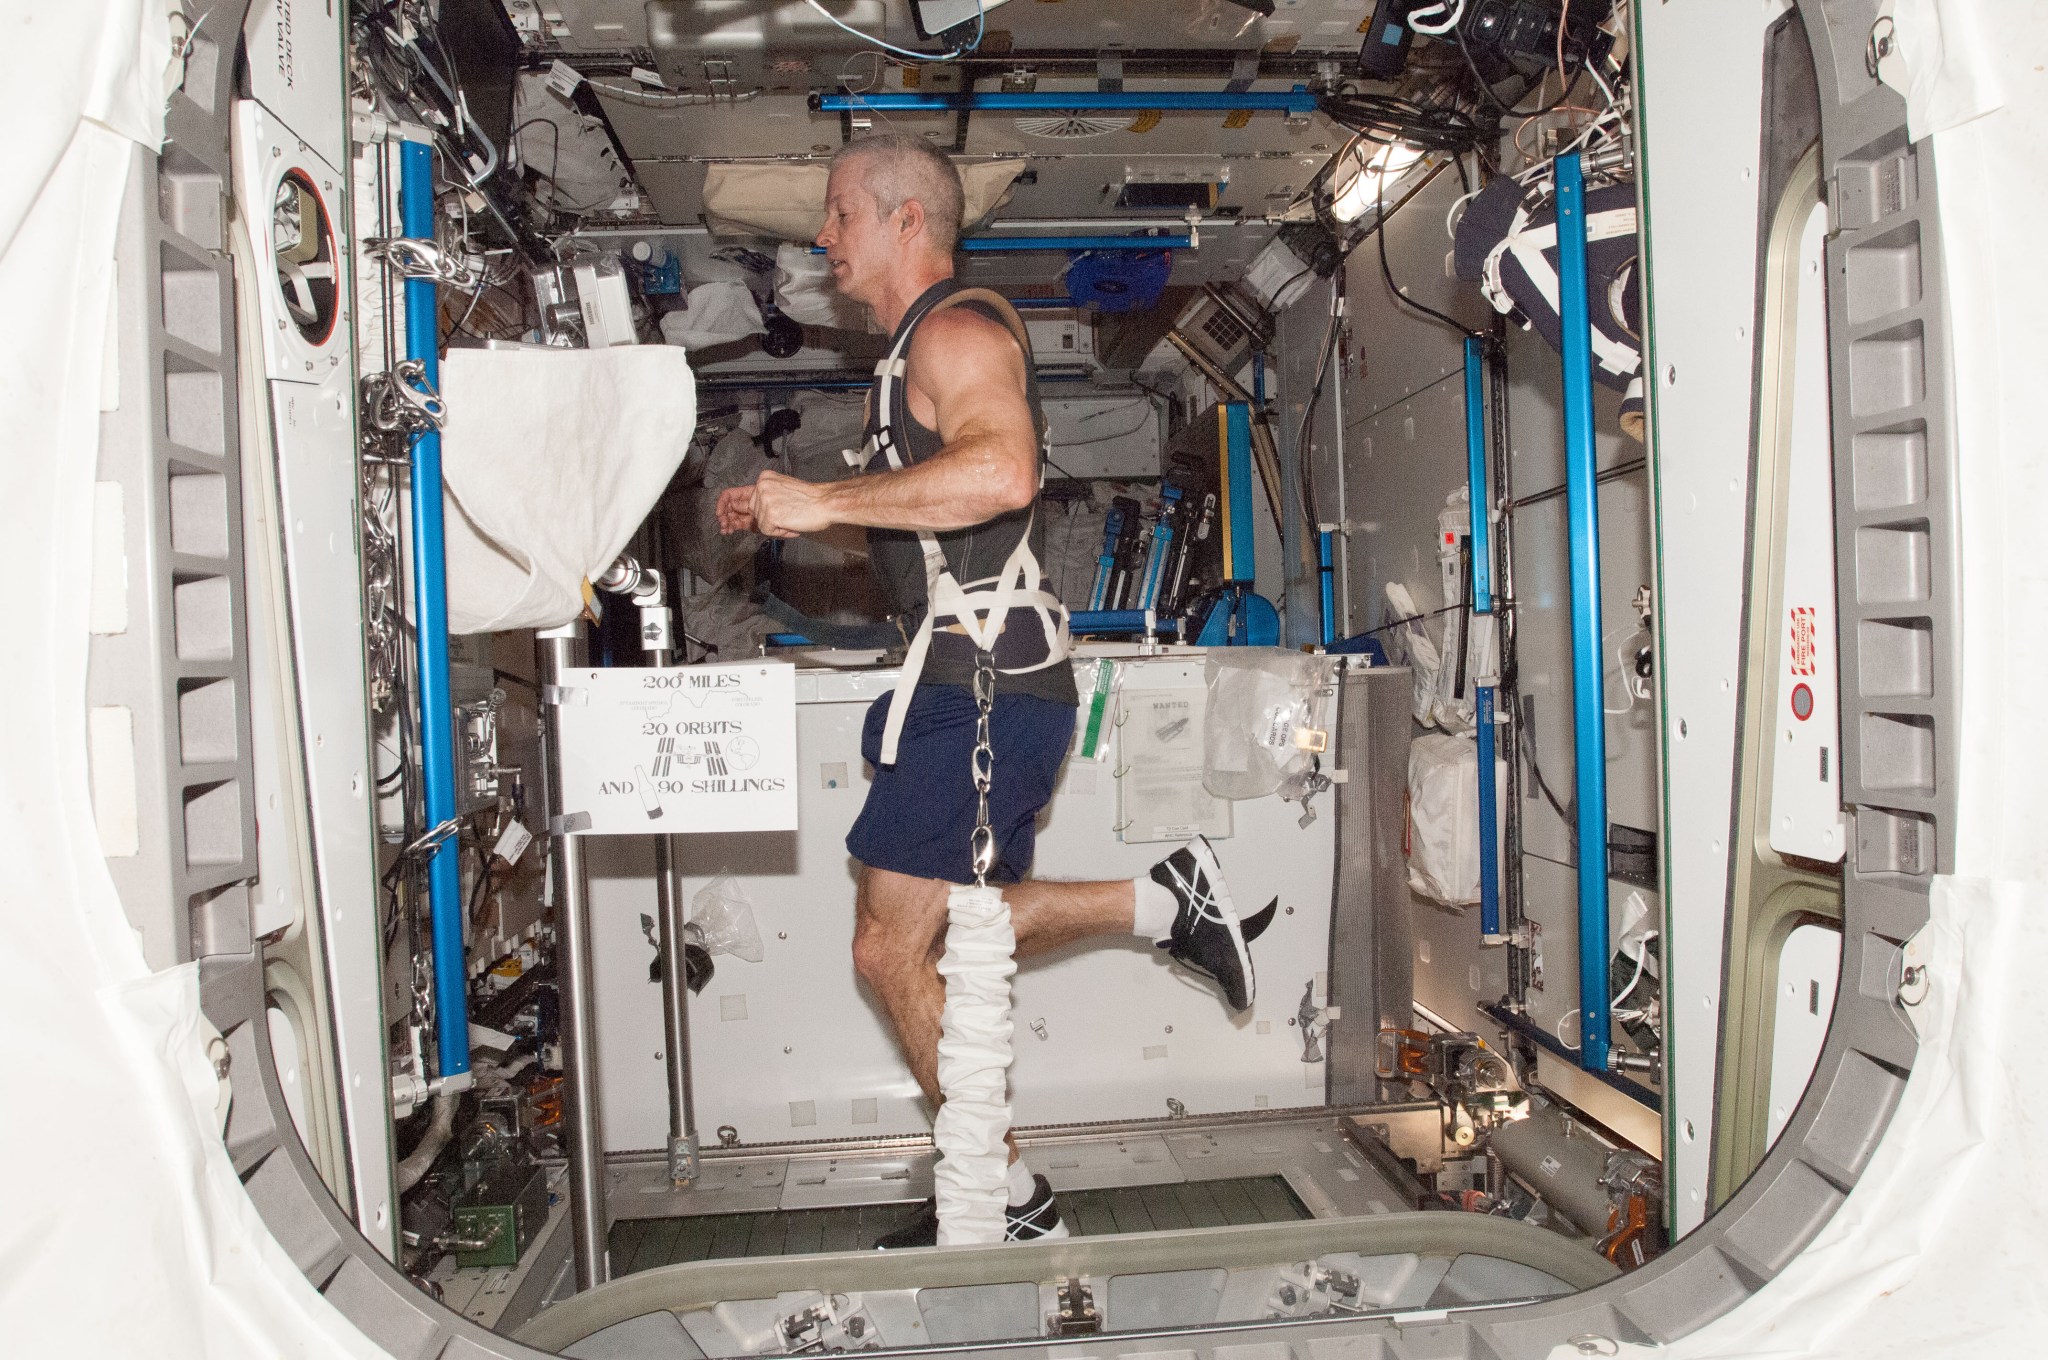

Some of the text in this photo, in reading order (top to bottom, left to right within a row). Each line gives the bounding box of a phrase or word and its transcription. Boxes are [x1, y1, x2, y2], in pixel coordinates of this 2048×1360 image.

[643, 674, 741, 689] 200 MILES
[642, 720, 742, 736] 20 ORBITS
[1268, 722, 1278, 746] CARDS
[1278, 733, 1287, 747] OPS
[598, 778, 785, 795] AND 90 SHILLINGS
